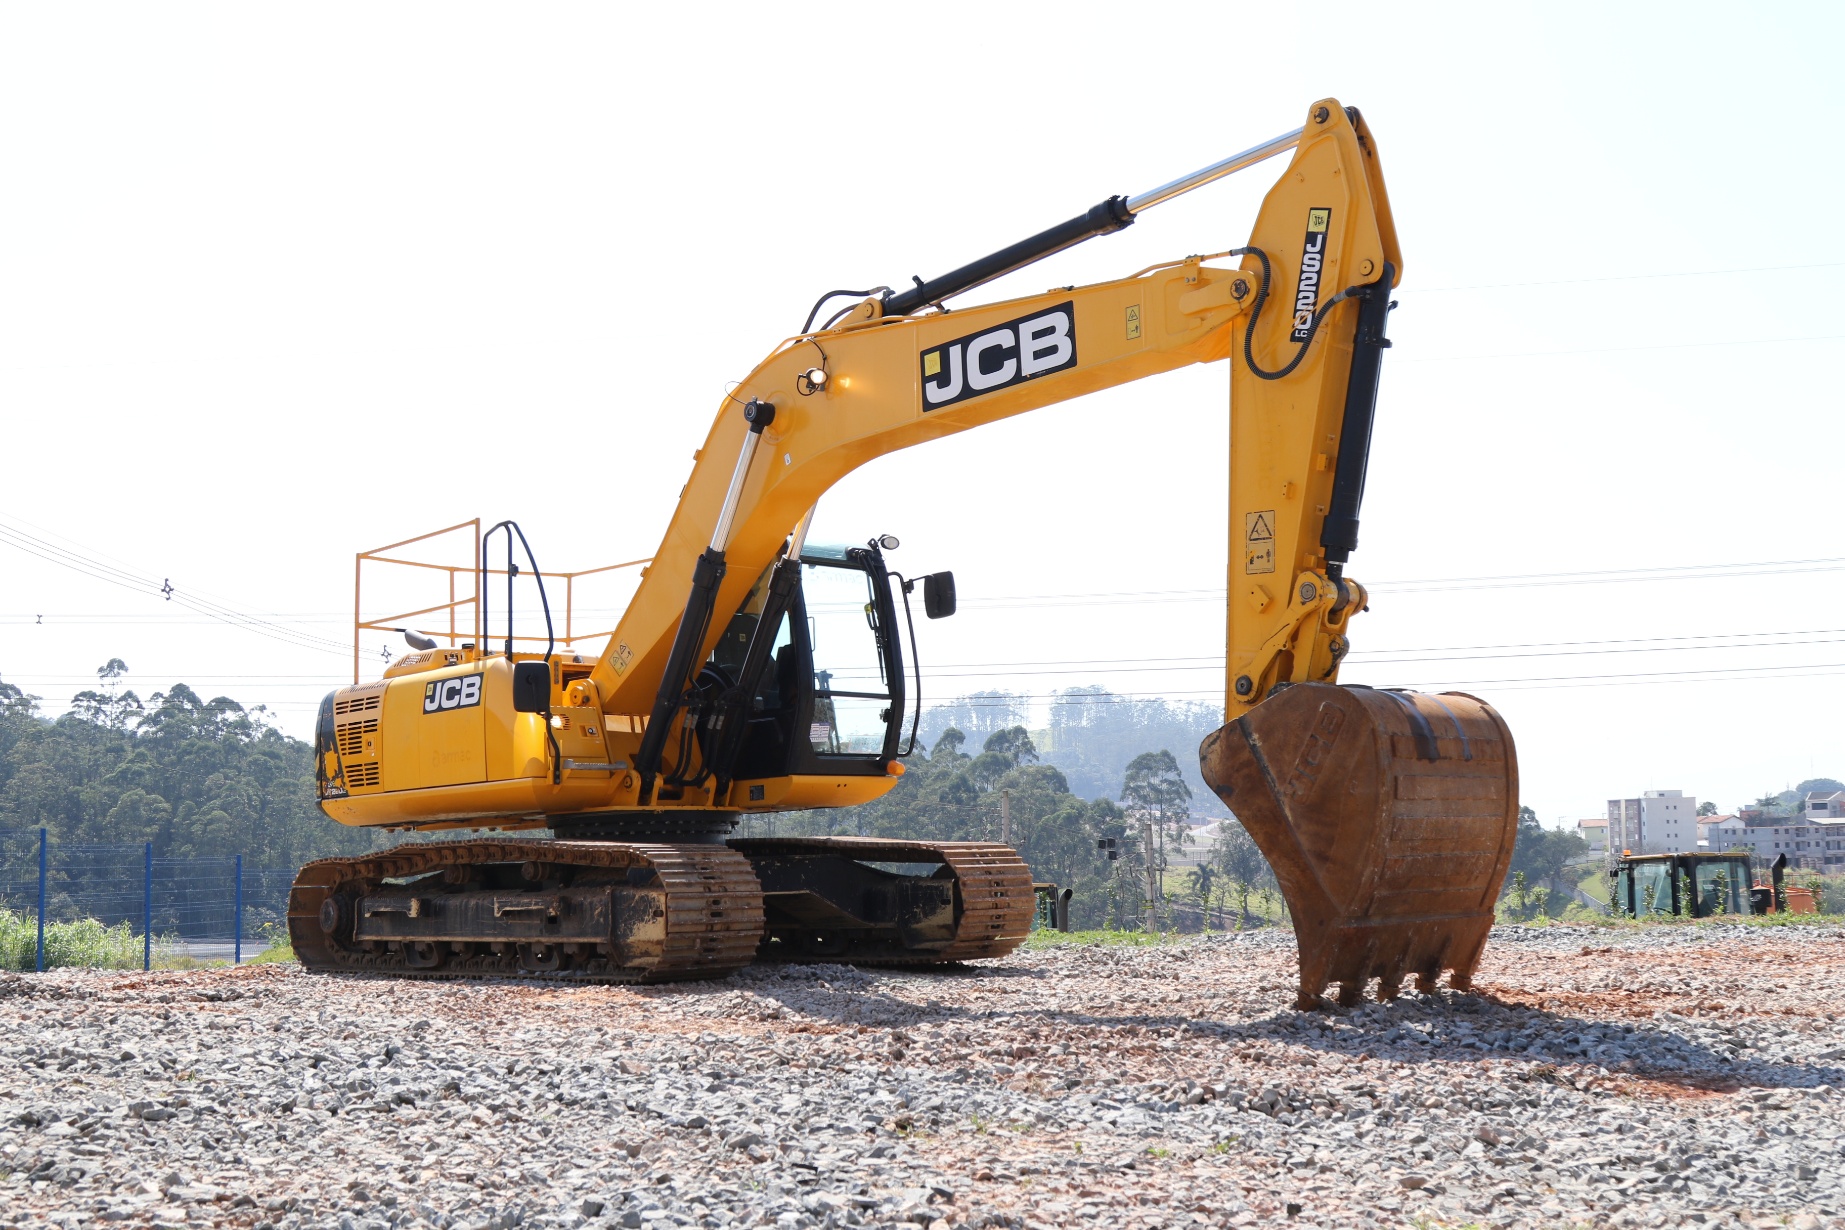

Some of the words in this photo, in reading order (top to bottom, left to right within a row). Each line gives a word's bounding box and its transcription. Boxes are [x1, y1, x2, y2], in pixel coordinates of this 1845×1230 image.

[1293, 234, 1323, 330] JS220
[925, 311, 1072, 404] JCB
[425, 676, 481, 711] JCB
